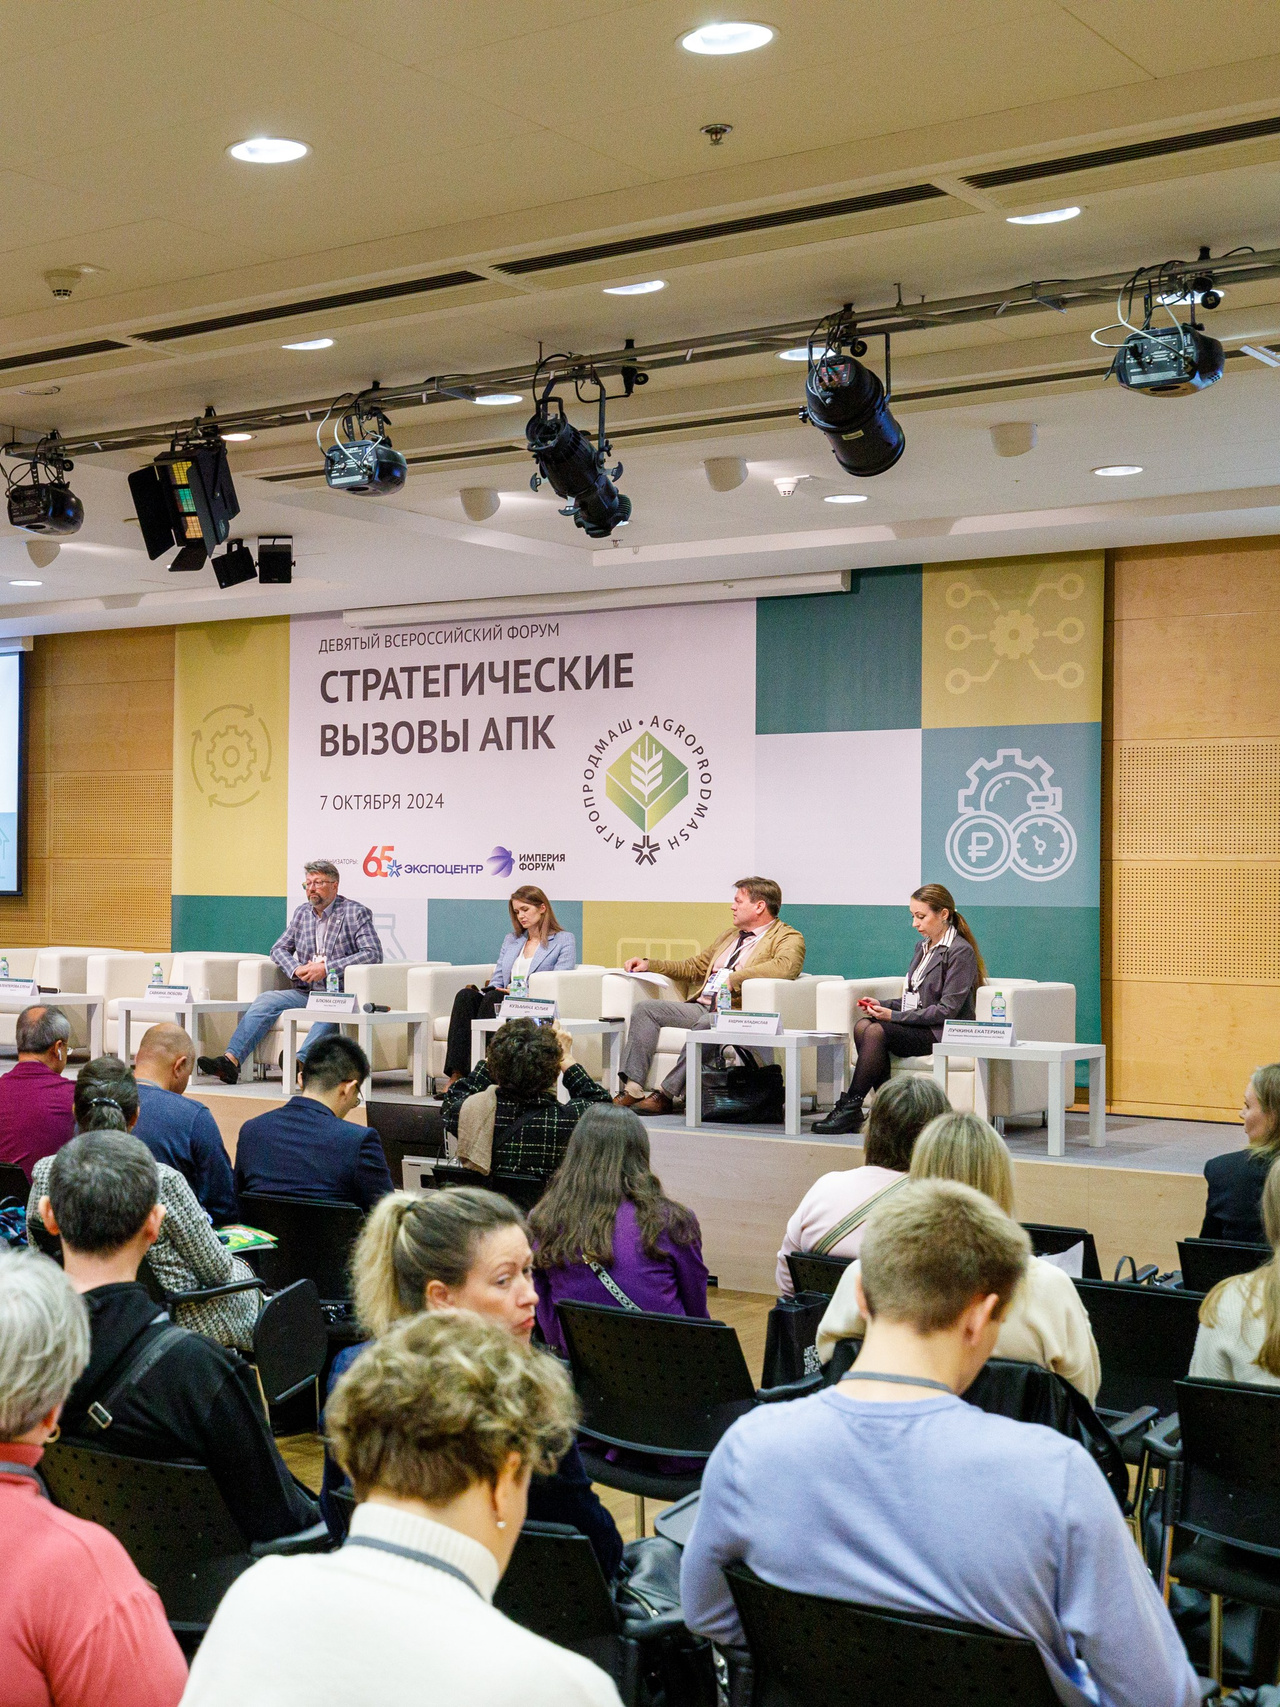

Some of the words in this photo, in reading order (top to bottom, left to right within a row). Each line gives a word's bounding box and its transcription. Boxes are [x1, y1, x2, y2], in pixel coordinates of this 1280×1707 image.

[319, 633, 380, 654] ДЕВЯТЫЙ
[385, 624, 502, 649] ВСЕРОССИЙСКИЙ
[507, 622, 559, 640] ФОРУМ
[319, 652, 634, 703] СТРАТЕГИЧЕСКИЕ
[319, 718, 469, 757] ВЫЗОВЫ
[479, 714, 556, 751] АПК
[582, 718, 633, 850] АГРОПРОДМАШ
[650, 715, 712, 850] AGROPRODMASH
[319, 795, 328, 811] 7
[333, 793, 402, 811] ОКТЯБРЯ
[406, 792, 445, 810] 2024
[362, 845, 394, 878] 65
[404, 864, 484, 875] ЭКСПОЦЕНТР
[519, 853, 566, 863] ИМПЕРИЯ
[519, 862, 556, 872] ФОРУМ
